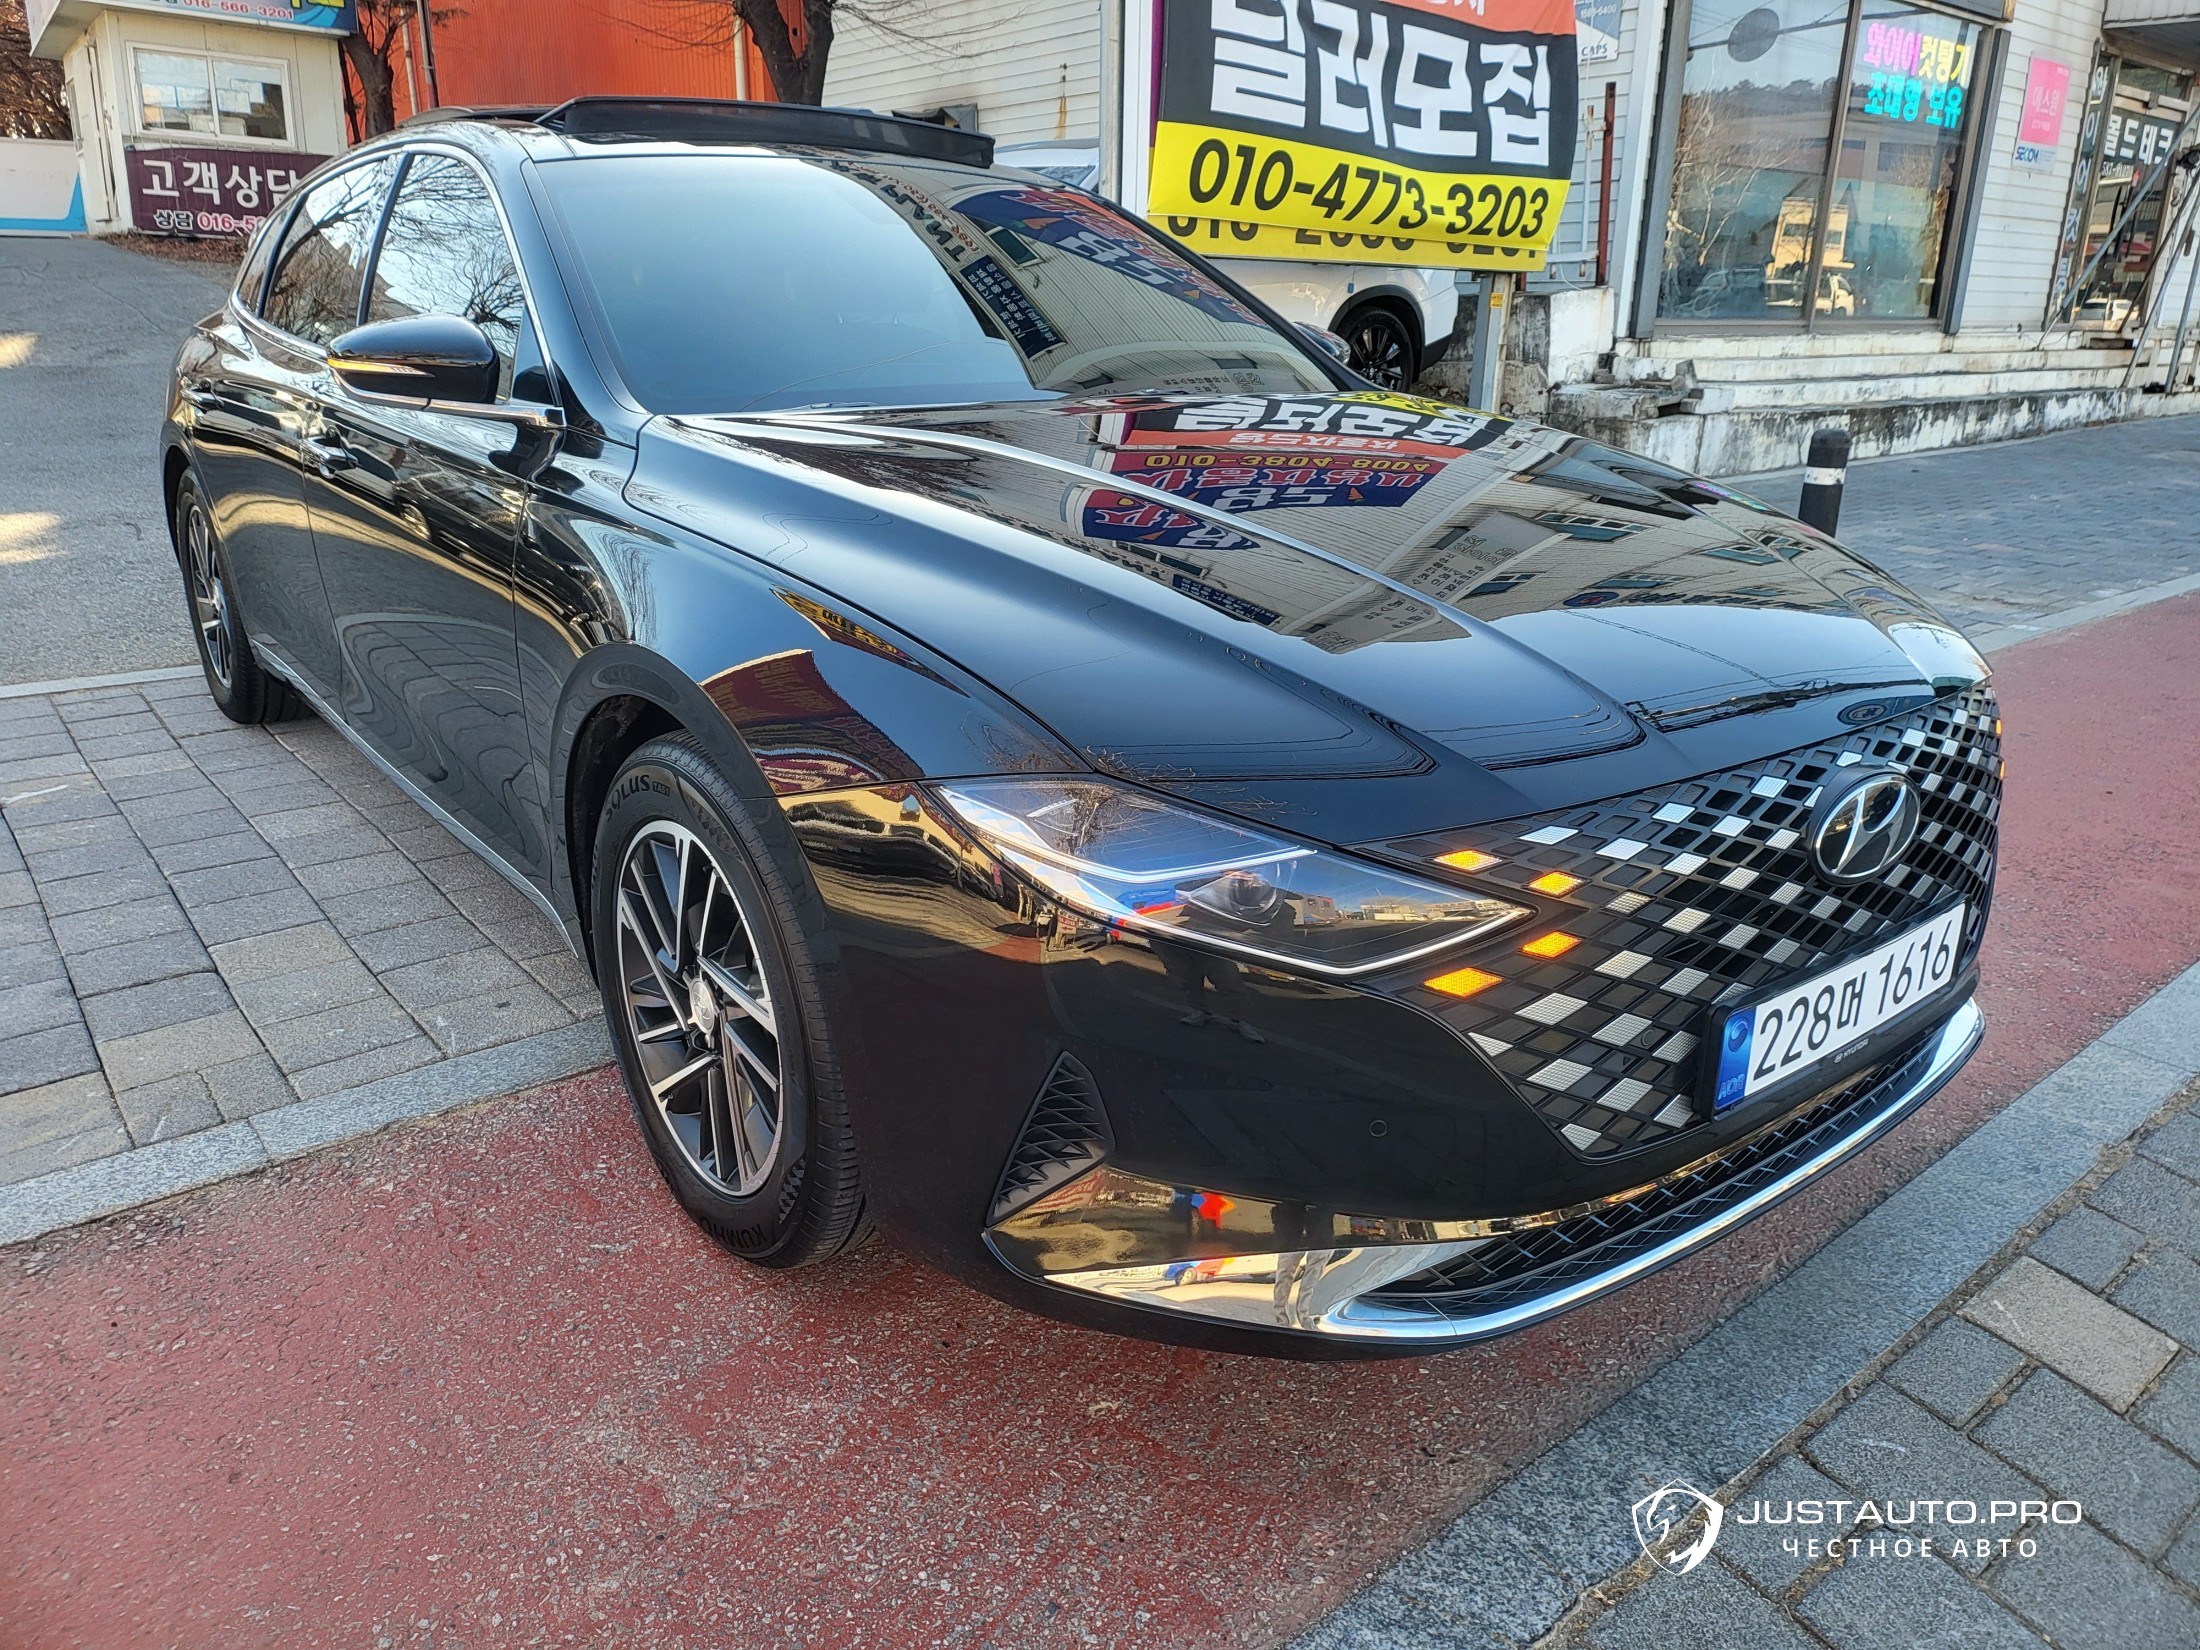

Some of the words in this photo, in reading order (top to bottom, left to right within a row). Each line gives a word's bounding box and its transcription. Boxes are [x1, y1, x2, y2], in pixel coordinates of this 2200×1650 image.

[1581, 43, 1608, 57] CAPS
[1210, 0, 1551, 168] 딜러모집
[1864, 71, 1923, 122] 초대형
[1926, 82, 1963, 129] 보유
[2015, 146, 2040, 163] SECOM
[1189, 138, 1550, 239] 010-4773-3203
[154, 209, 193, 230] 상담
[1753, 970, 1867, 1081] 228머
[1878, 919, 1953, 1016] 1616
